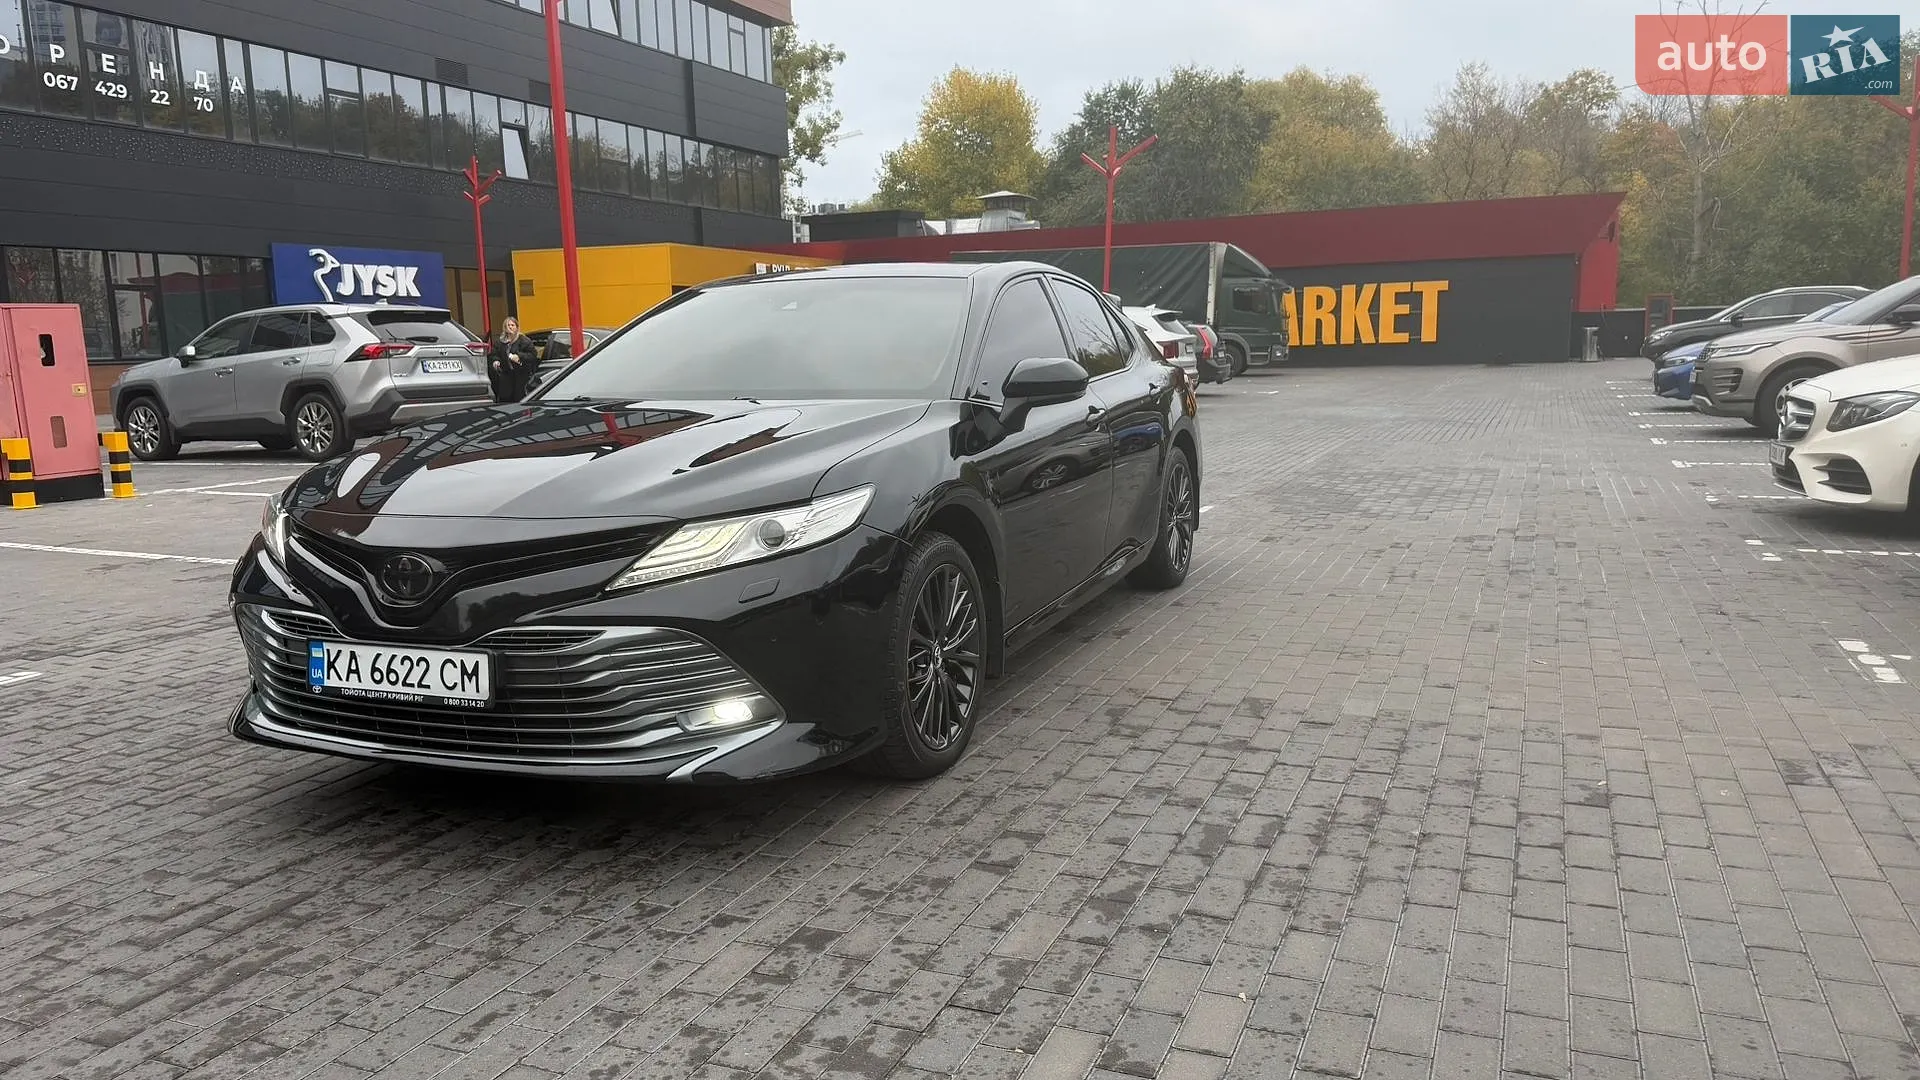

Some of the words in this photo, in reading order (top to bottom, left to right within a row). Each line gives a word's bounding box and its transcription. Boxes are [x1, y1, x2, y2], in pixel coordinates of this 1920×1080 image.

[43, 71, 79, 91] 067
[95, 80, 128, 99] 429
[150, 89, 171, 106] 22
[193, 96, 214, 113] 70
[336, 263, 421, 297] JYSK
[311, 668, 324, 679] UA
[326, 648, 362, 684] KA
[370, 652, 431, 690] 6622
[439, 658, 480, 694] CM
[341, 688, 366, 697] ТОЙОТА
[366, 690, 387, 699] ЦЕНТР
[387, 692, 414, 702] КРИВИЙ
